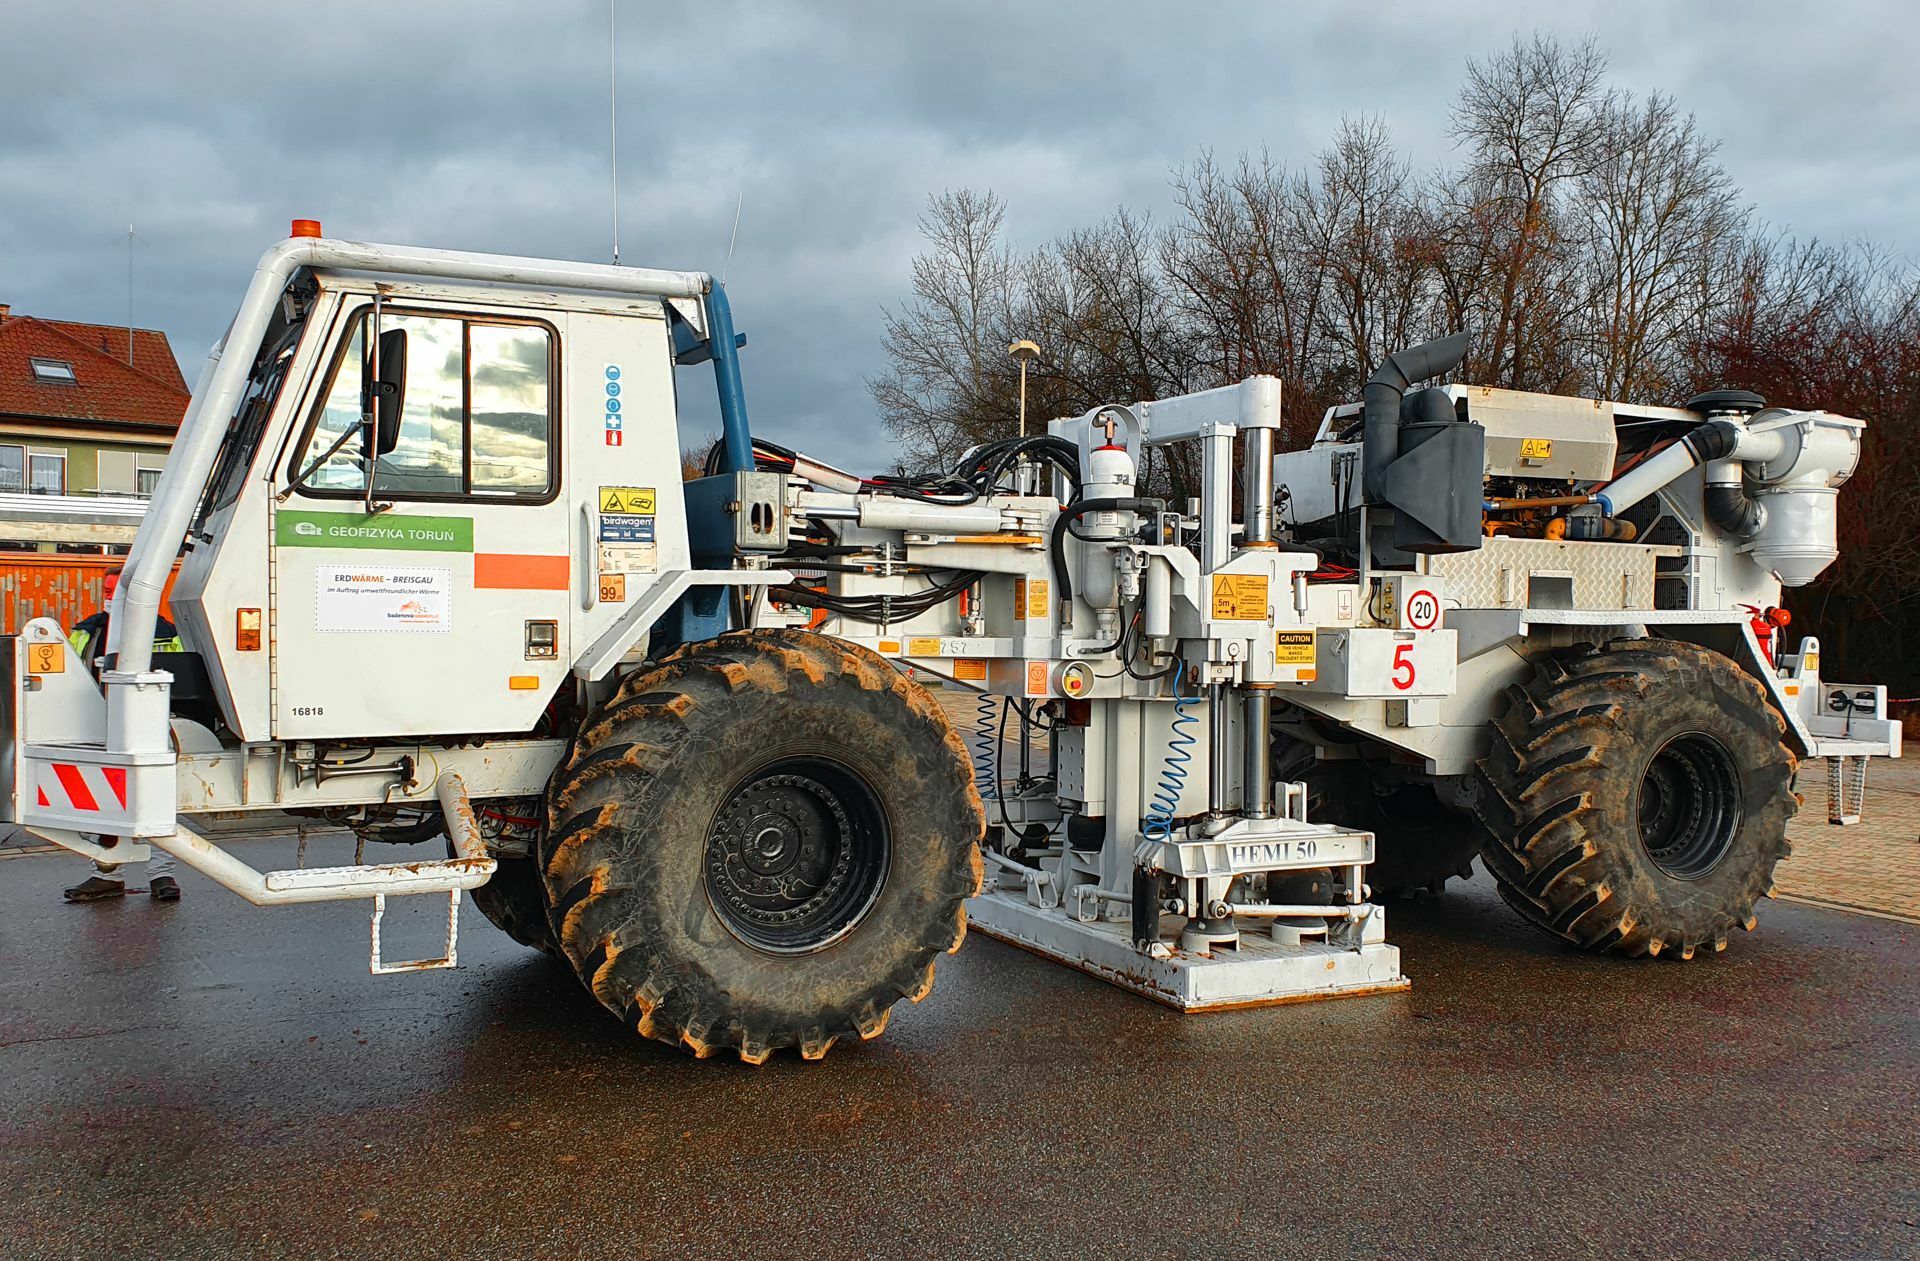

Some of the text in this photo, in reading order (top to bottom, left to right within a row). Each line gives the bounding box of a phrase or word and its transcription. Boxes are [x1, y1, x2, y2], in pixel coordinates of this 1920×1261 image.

[329, 526, 454, 541] GEOFIZYKA TORUŃ
[334, 573, 385, 583] ERDWÄRME
[392, 576, 434, 584] BREISGAU
[336, 587, 360, 595] Auftrag
[601, 586, 616, 600] 99
[1218, 598, 1230, 607] 5m
[1414, 601, 1432, 619] 20
[1280, 635, 1311, 643] CAUTION
[1391, 644, 1415, 690] 5
[291, 707, 324, 716] 16818
[1231, 840, 1317, 864] HEMI 50
